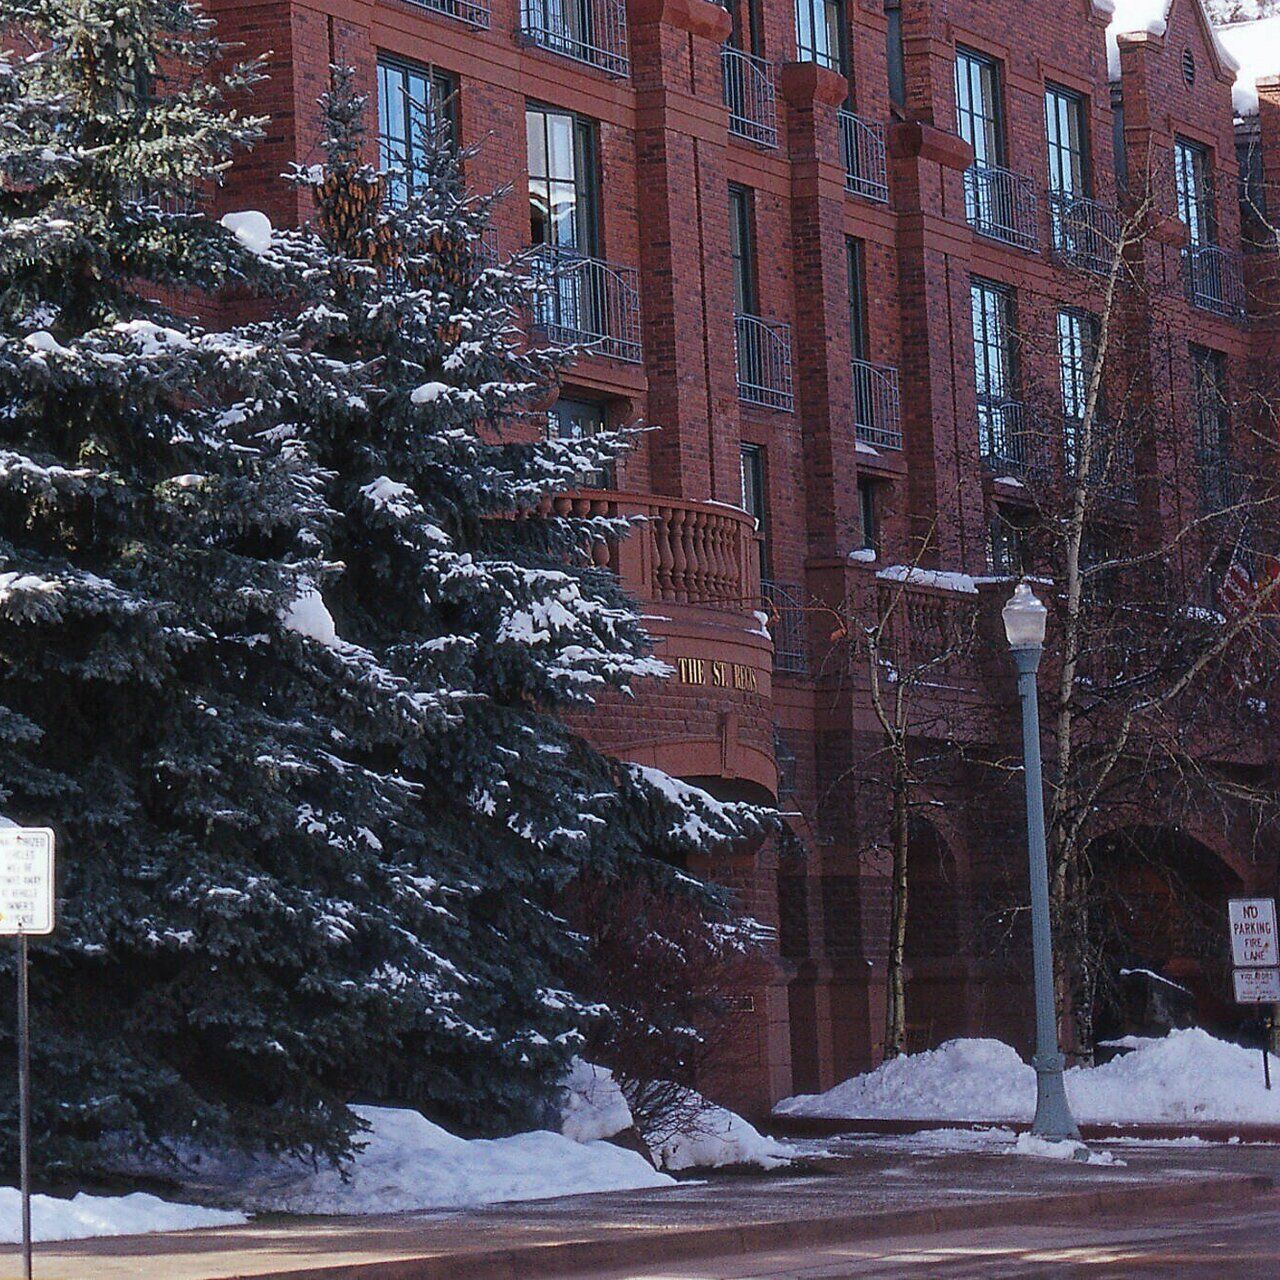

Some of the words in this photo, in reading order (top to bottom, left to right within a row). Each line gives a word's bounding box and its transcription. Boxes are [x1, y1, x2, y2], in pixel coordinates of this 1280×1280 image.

[678, 657, 705, 684] THE
[712, 661, 729, 687] ST.
[734, 664, 757, 690] REGIS
[1242, 906, 1259, 919] NO
[1233, 923, 1271, 935] PARKING
[1244, 938, 1262, 947] FIRE
[1244, 951, 1266, 961] LANE
